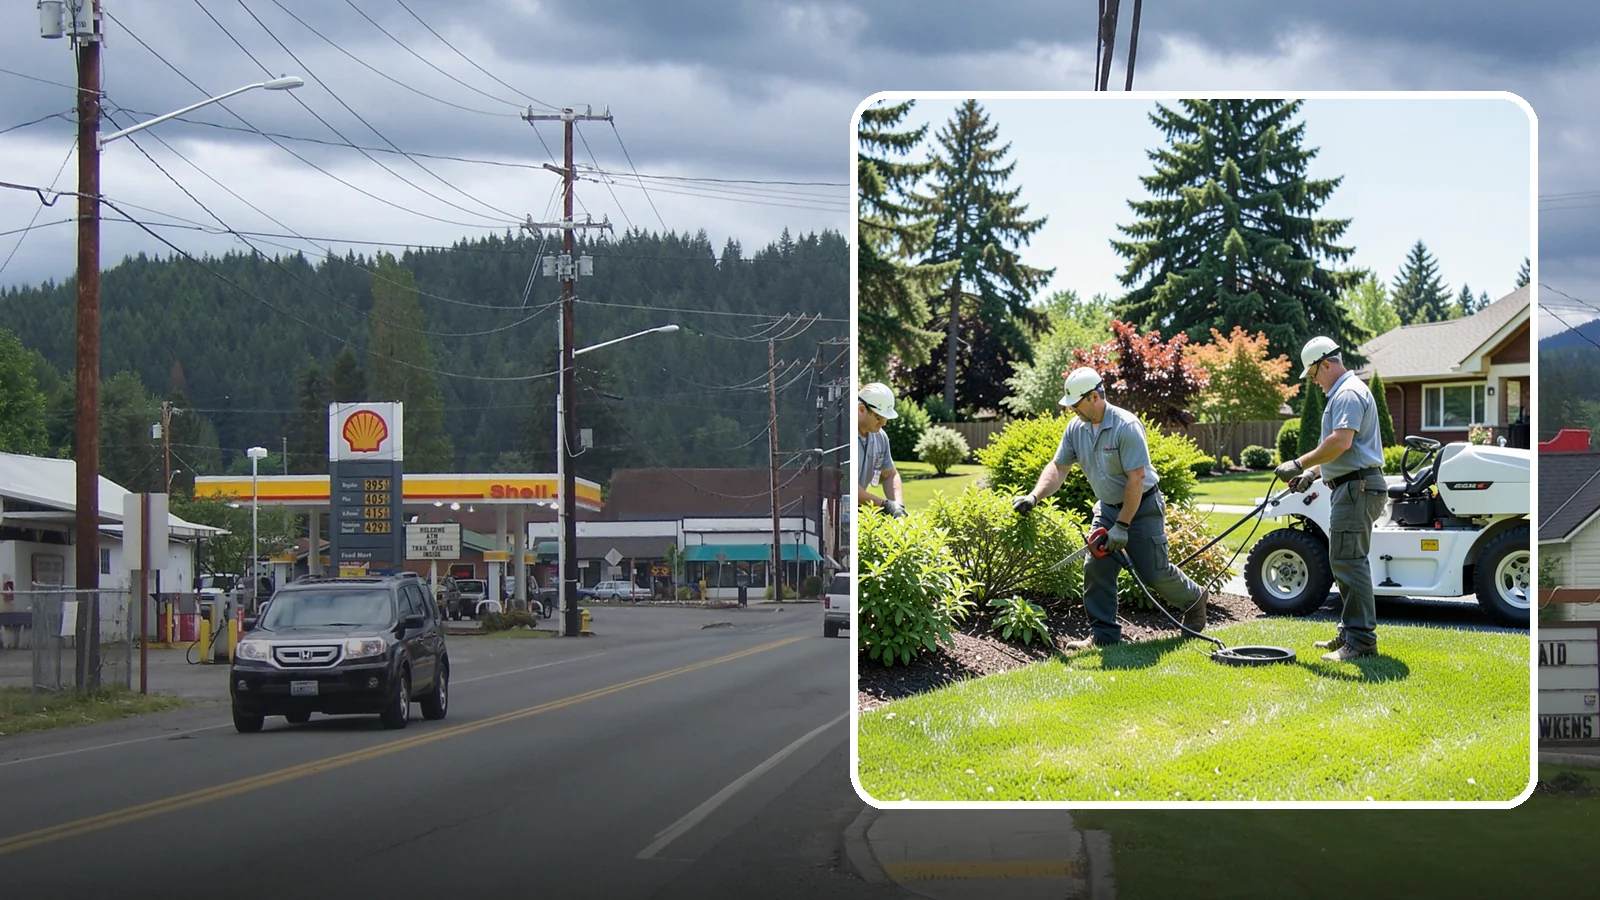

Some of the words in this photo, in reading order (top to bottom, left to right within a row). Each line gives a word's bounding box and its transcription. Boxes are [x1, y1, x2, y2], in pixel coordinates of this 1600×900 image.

[365, 480, 383, 490] 395
[490, 484, 547, 499] Shell
[365, 494, 383, 504] 405
[365, 508, 383, 518] 415
[365, 522, 383, 533] 429
[1538, 642, 1567, 666] AID
